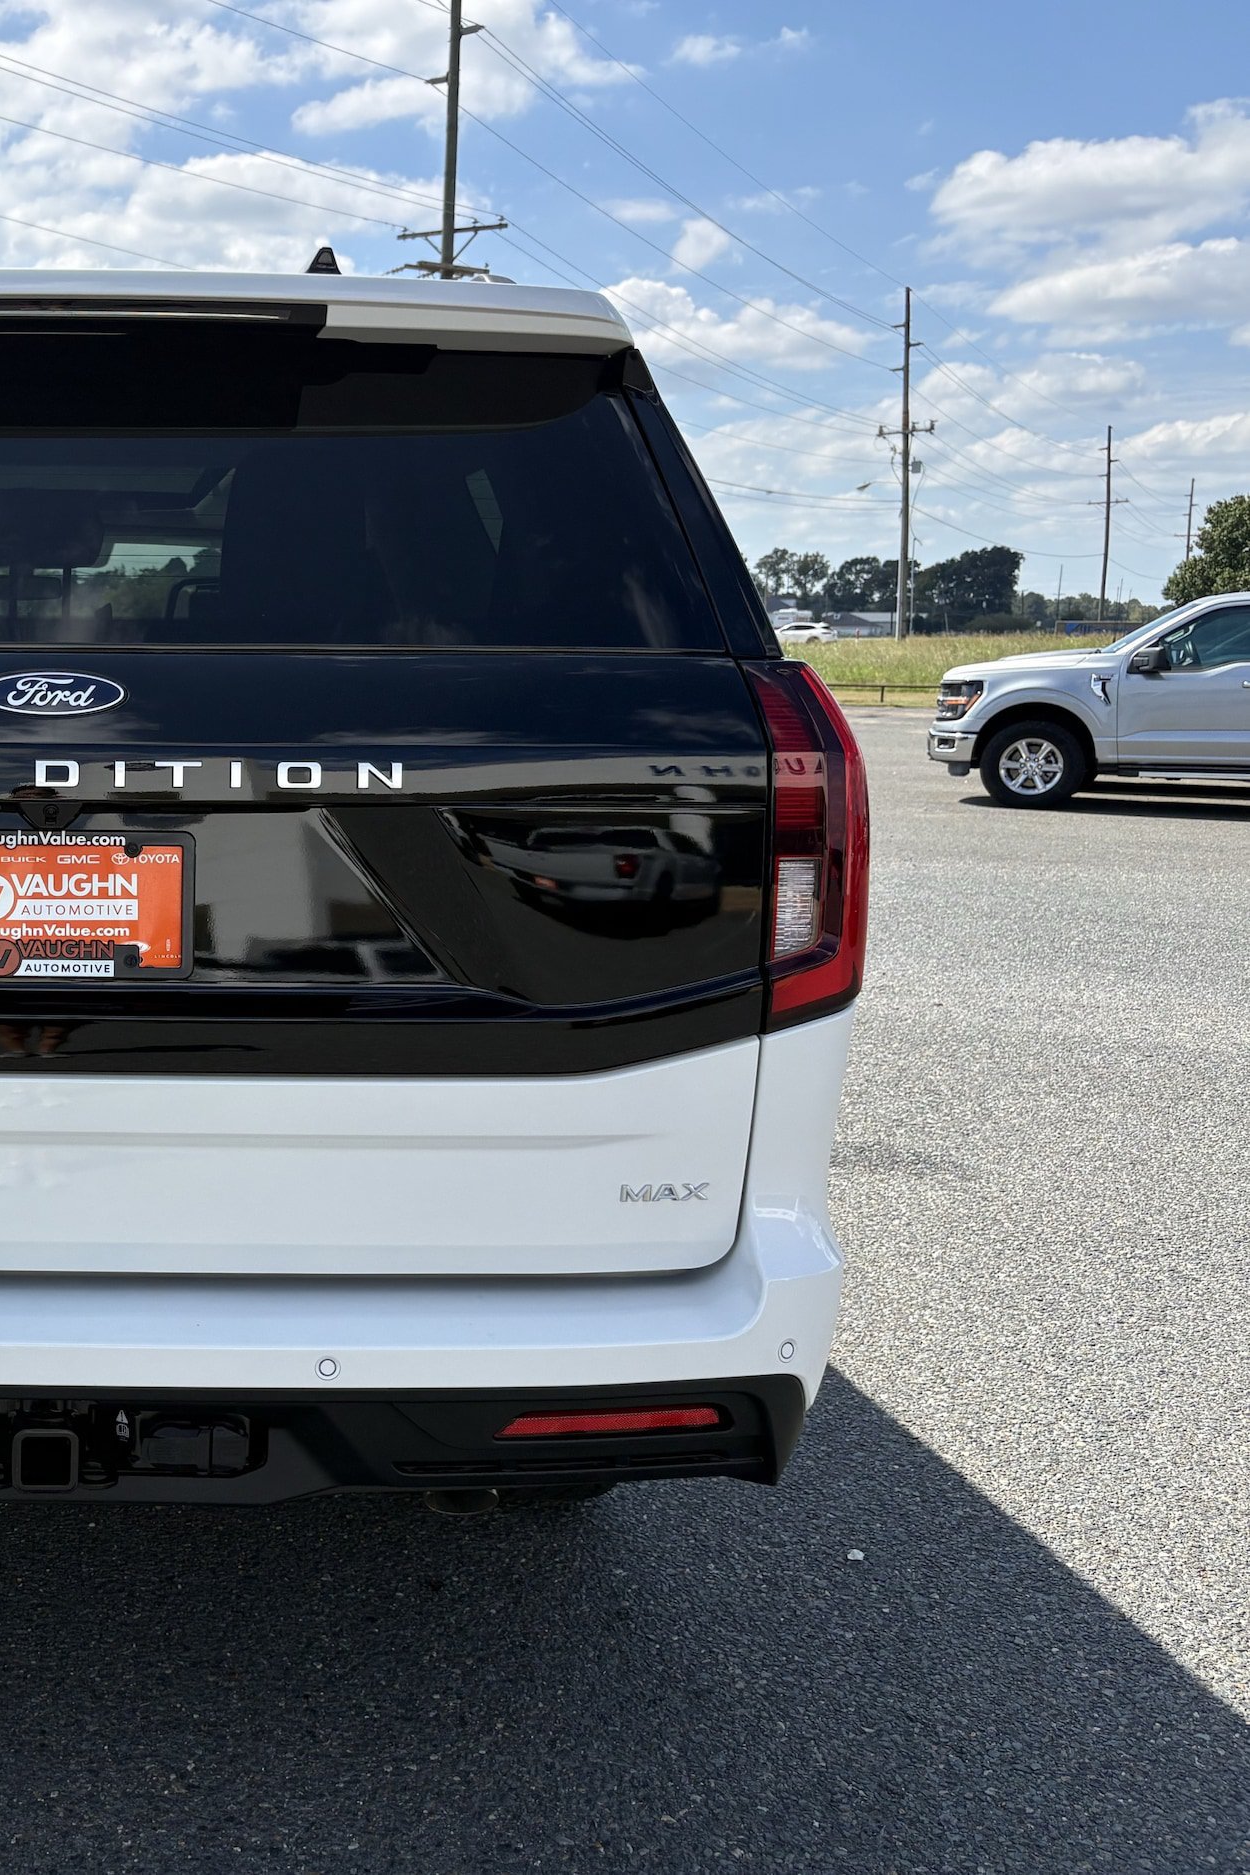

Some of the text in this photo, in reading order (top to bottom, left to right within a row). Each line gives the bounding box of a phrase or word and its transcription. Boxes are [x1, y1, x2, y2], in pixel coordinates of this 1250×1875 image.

[6, 676, 95, 708] Ford
[57, 855, 100, 864] GMC
[10, 873, 138, 897] VAUGHN
[21, 905, 134, 916] AUTOMOTIVE
[15, 940, 114, 959] VAUGHN
[24, 964, 111, 973] AUTOMOTIVE
[619, 1182, 710, 1202] MAX
